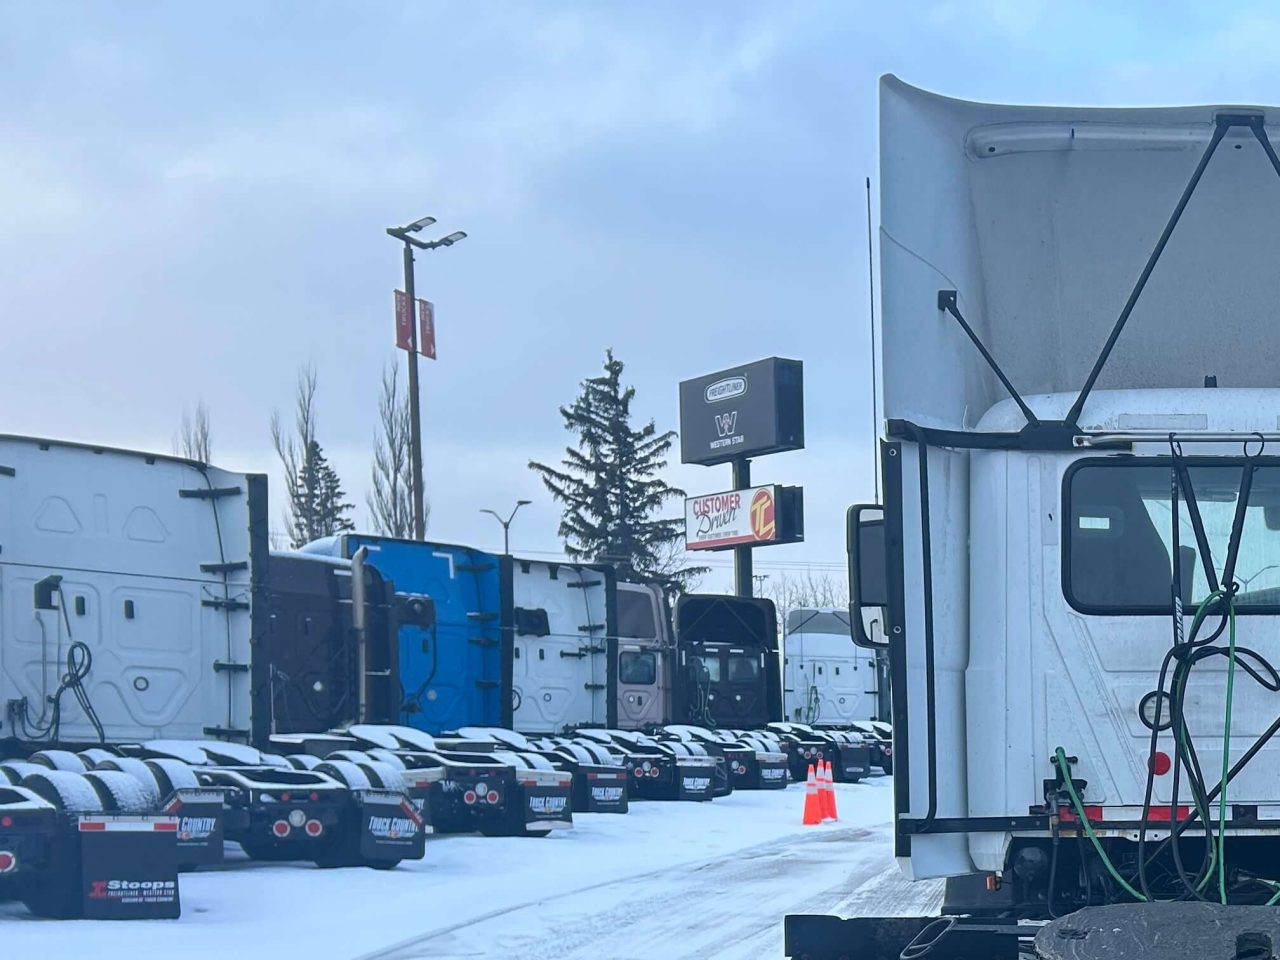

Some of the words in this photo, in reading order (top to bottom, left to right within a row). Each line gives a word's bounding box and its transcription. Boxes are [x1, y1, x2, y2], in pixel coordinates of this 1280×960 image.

[693, 493, 741, 516] CUSTOMER
[696, 507, 736, 537] Driven
[529, 797, 545, 808] TRUCK
[545, 797, 567, 808] COUNTRY
[182, 817, 217, 831] COUNTRY
[369, 816, 392, 831] TRUCK
[107, 880, 175, 889] Stoops
